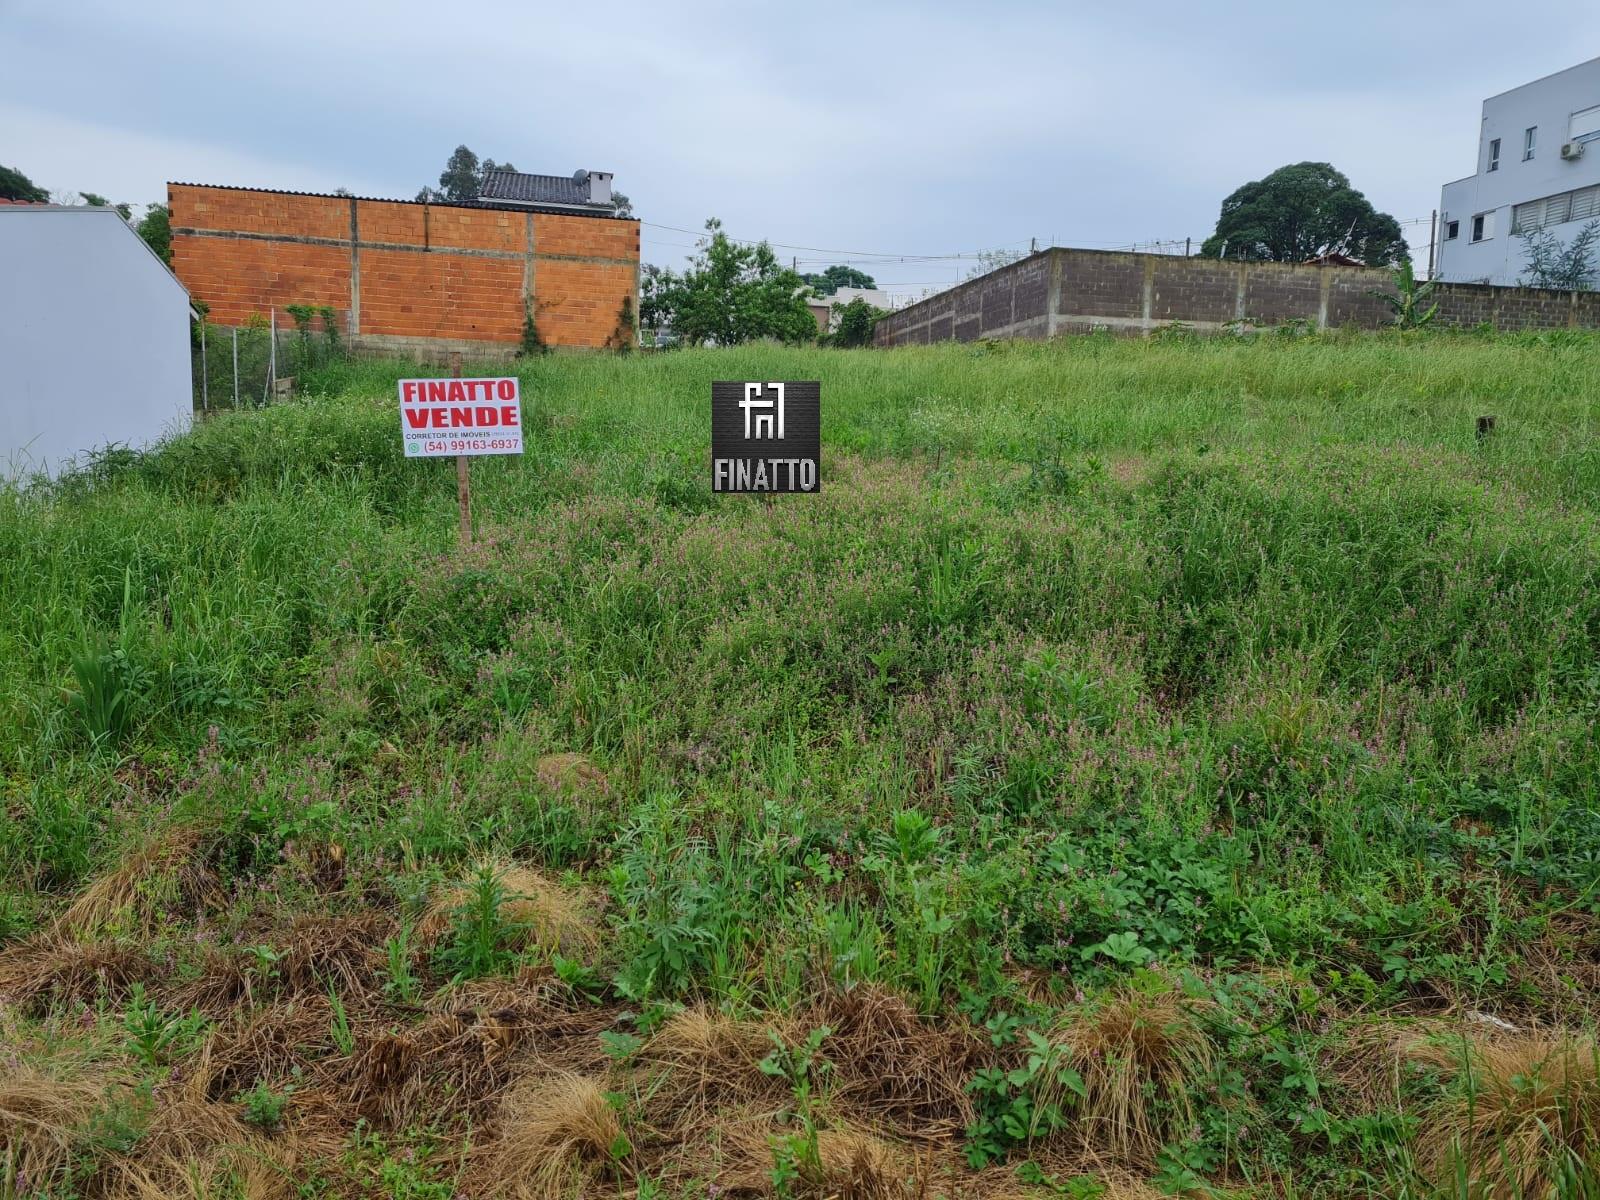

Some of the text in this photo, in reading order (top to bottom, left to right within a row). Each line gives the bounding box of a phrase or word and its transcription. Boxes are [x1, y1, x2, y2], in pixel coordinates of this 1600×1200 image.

[403, 380, 515, 402] FINATTO
[405, 406, 518, 428] VENDE
[406, 432, 447, 440] CORRETOR
[424, 439, 519, 453] (54) 99163-6937
